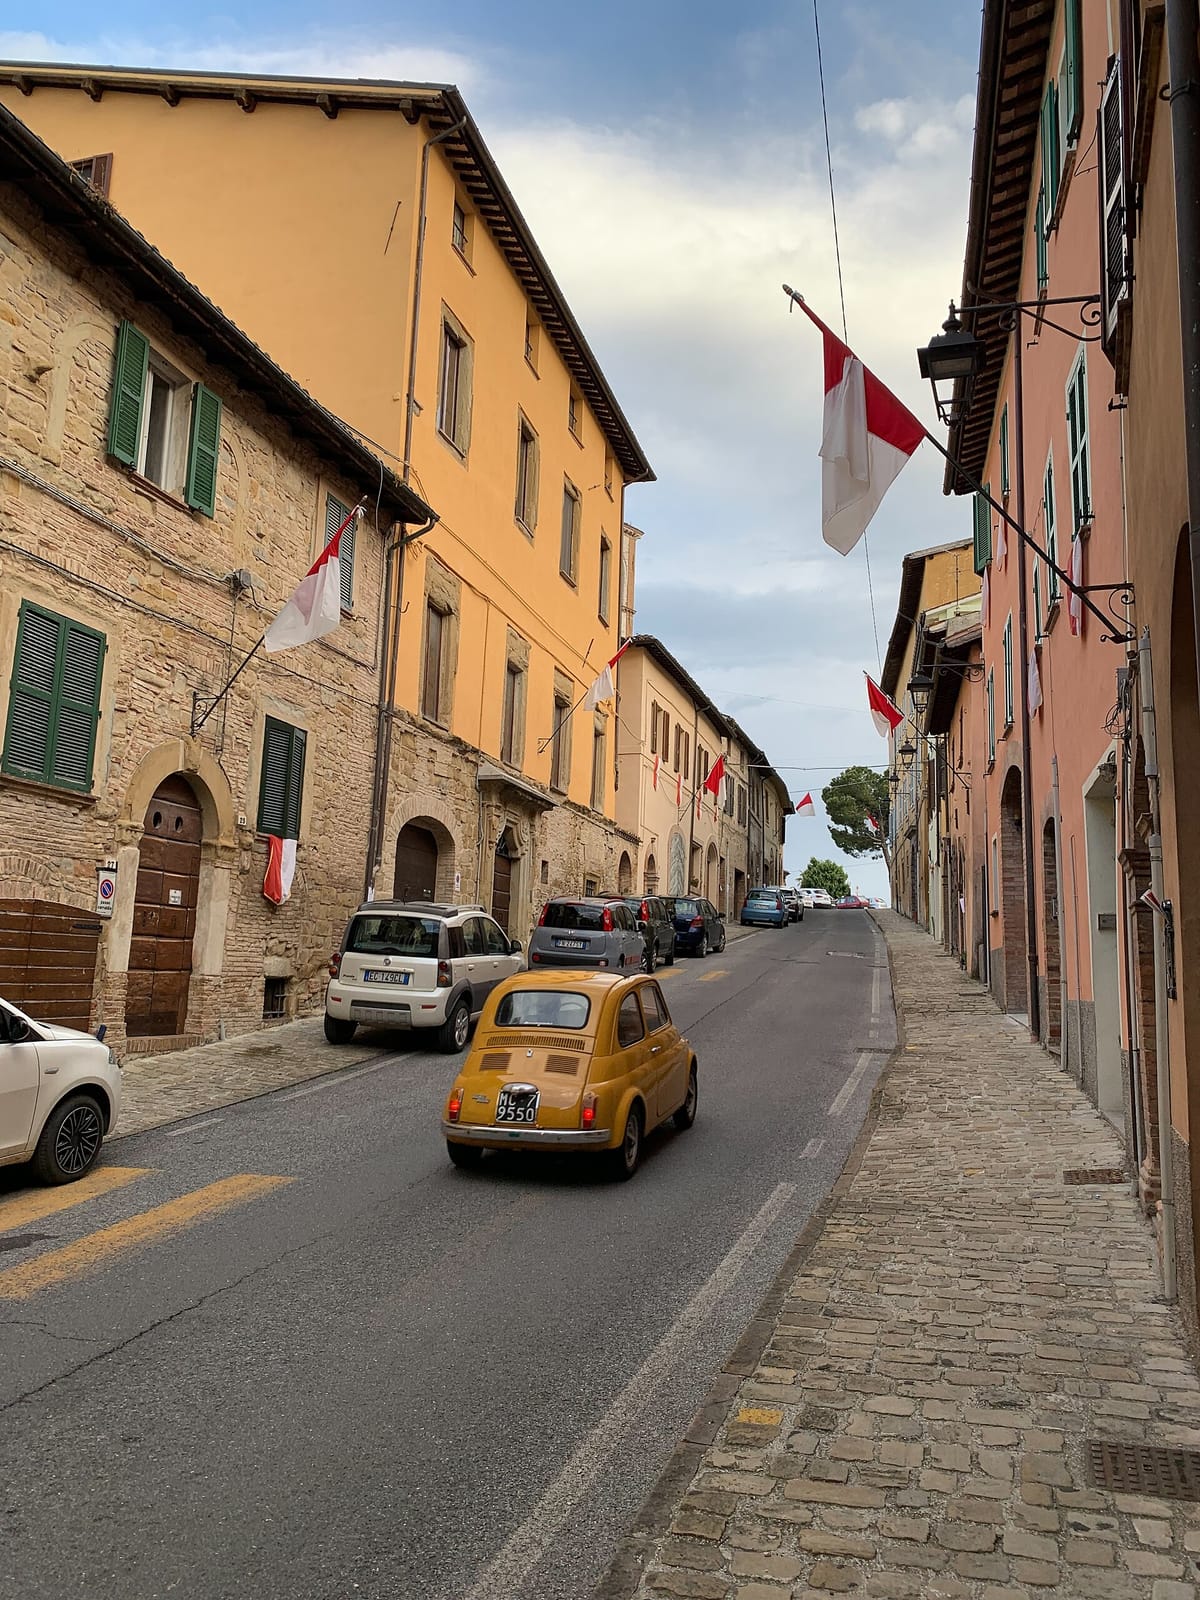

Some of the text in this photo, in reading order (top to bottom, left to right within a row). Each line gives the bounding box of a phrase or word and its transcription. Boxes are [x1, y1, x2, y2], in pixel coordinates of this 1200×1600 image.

[499, 1093, 516, 1106] MC
[526, 1095, 536, 1108] 7
[497, 1106, 535, 1122] 9550
